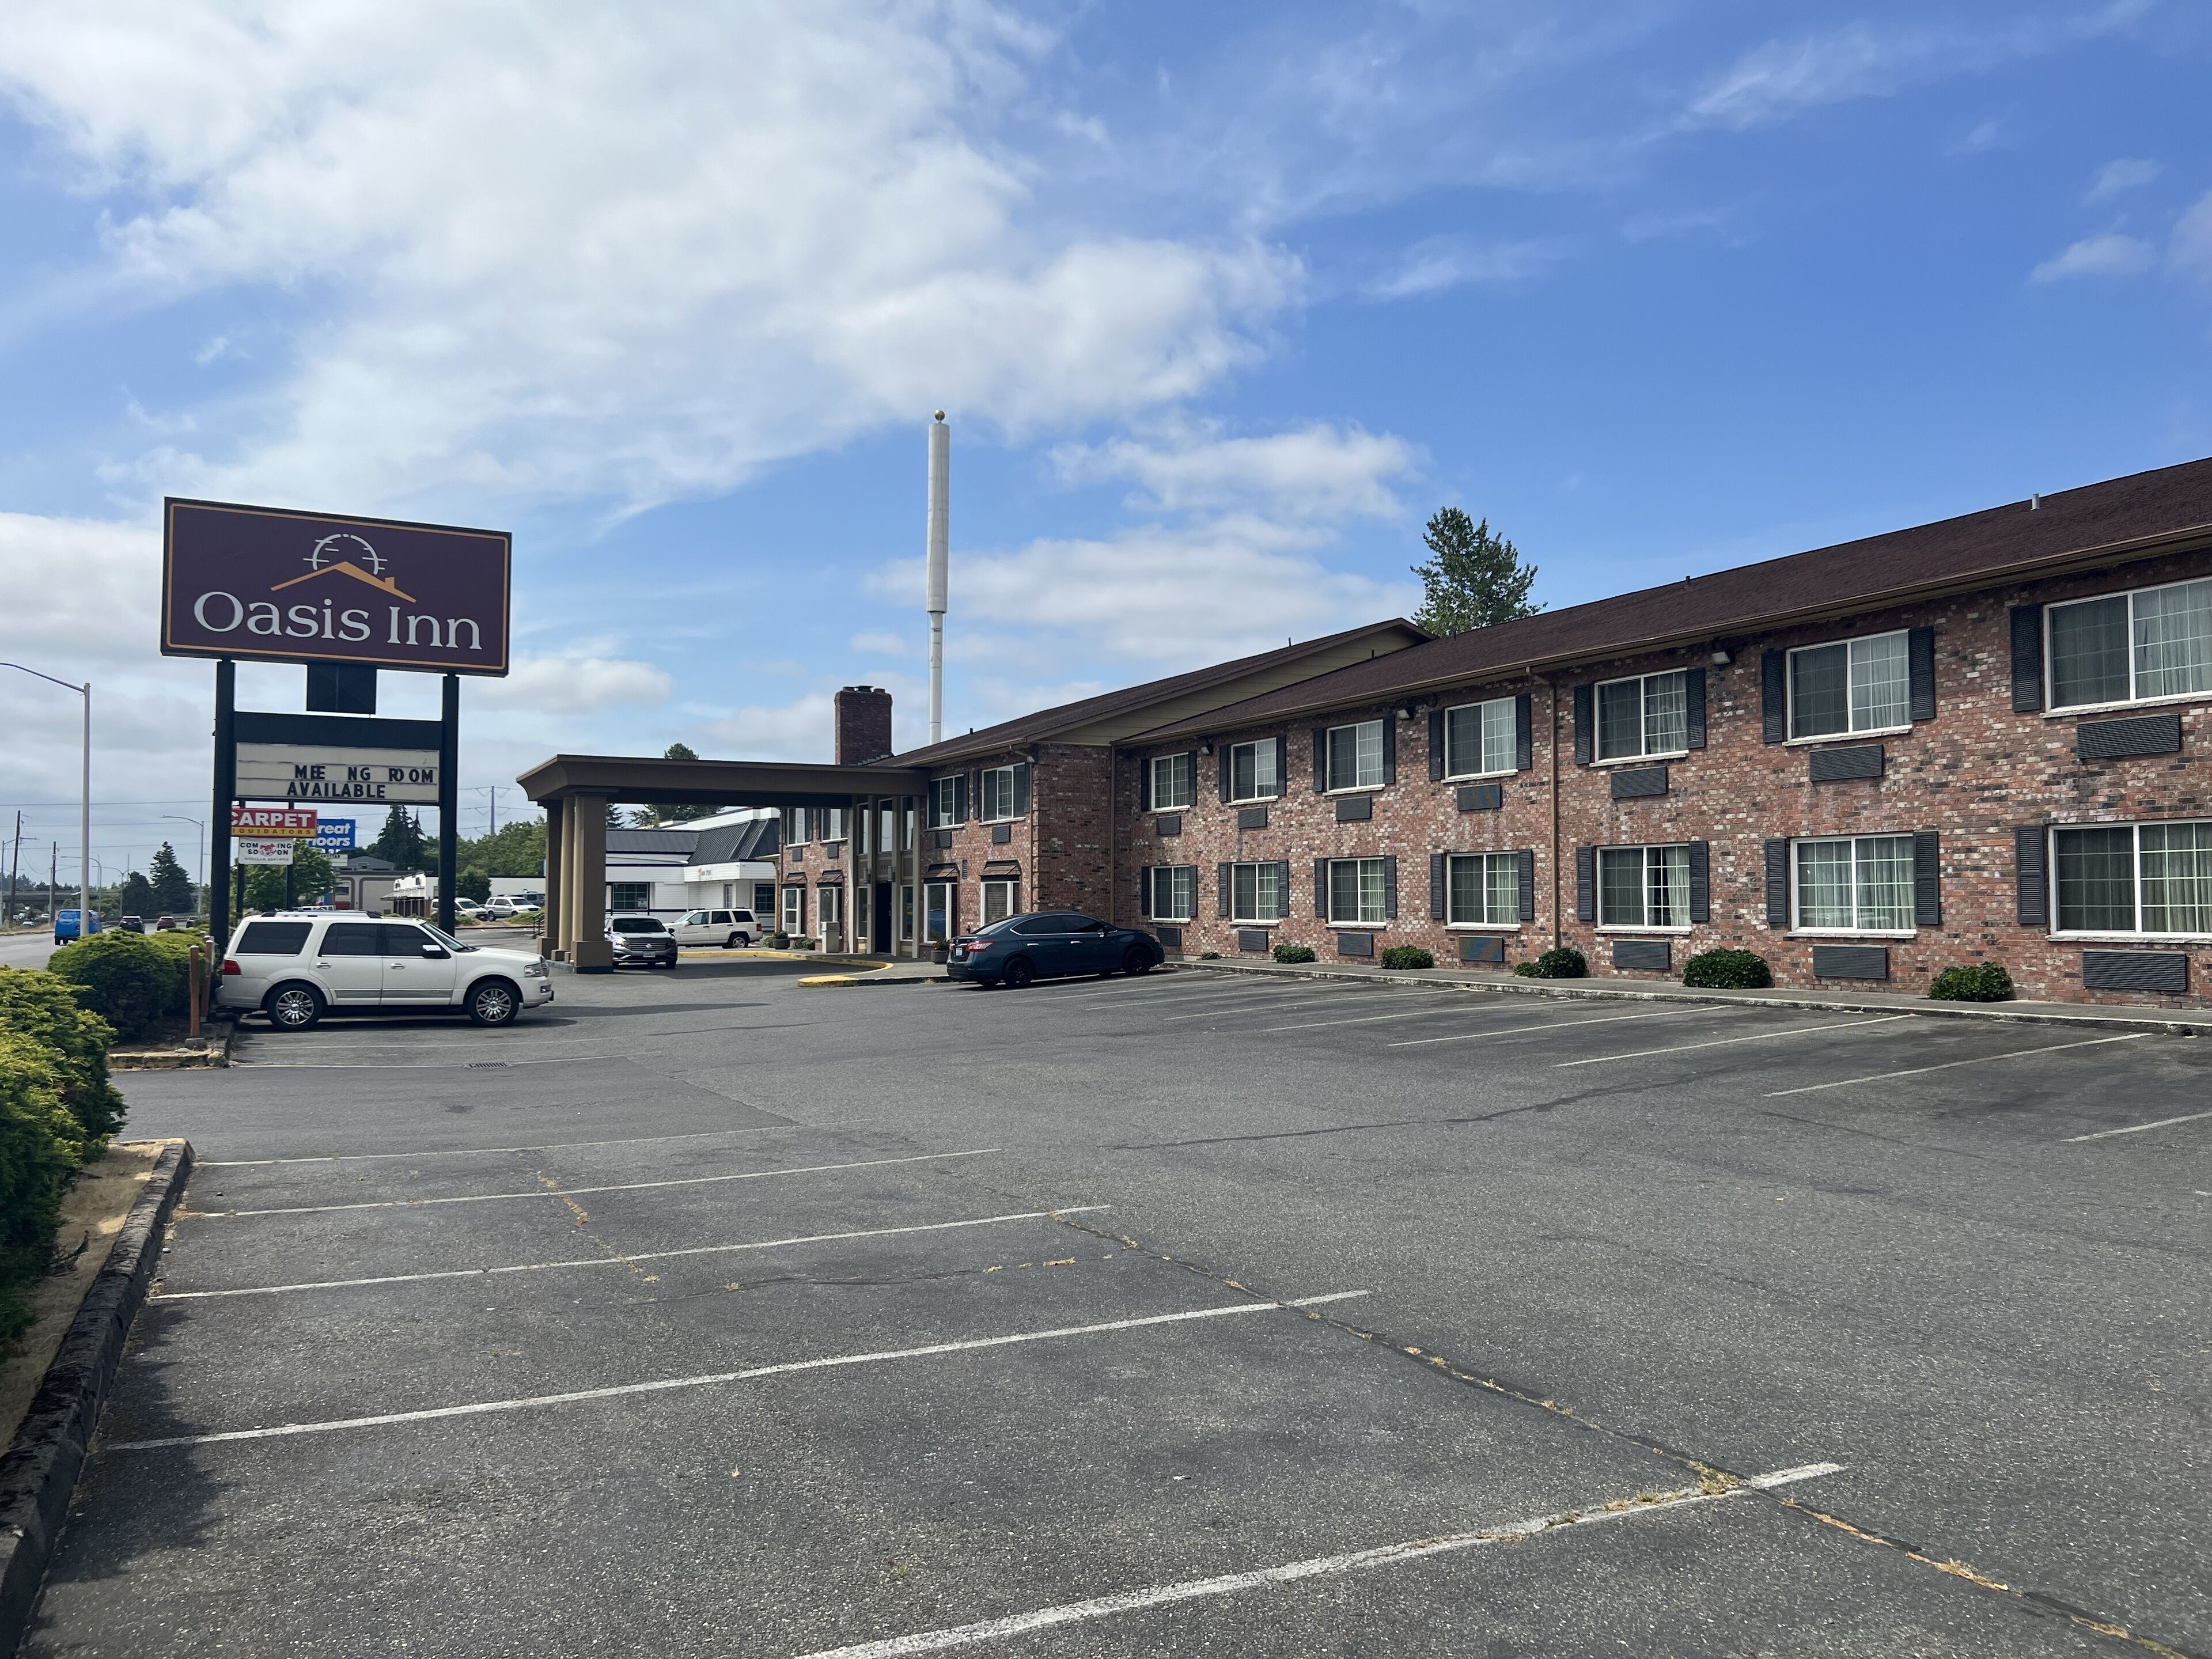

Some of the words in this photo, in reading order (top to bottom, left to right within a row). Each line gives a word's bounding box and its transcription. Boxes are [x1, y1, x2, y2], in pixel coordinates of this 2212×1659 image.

[193, 591, 371, 642] Oasis
[387, 606, 483, 650] Inn
[388, 768, 434, 783] ROOM
[287, 782, 386, 798] AVAILABLE
[317, 823, 351, 835] reat
